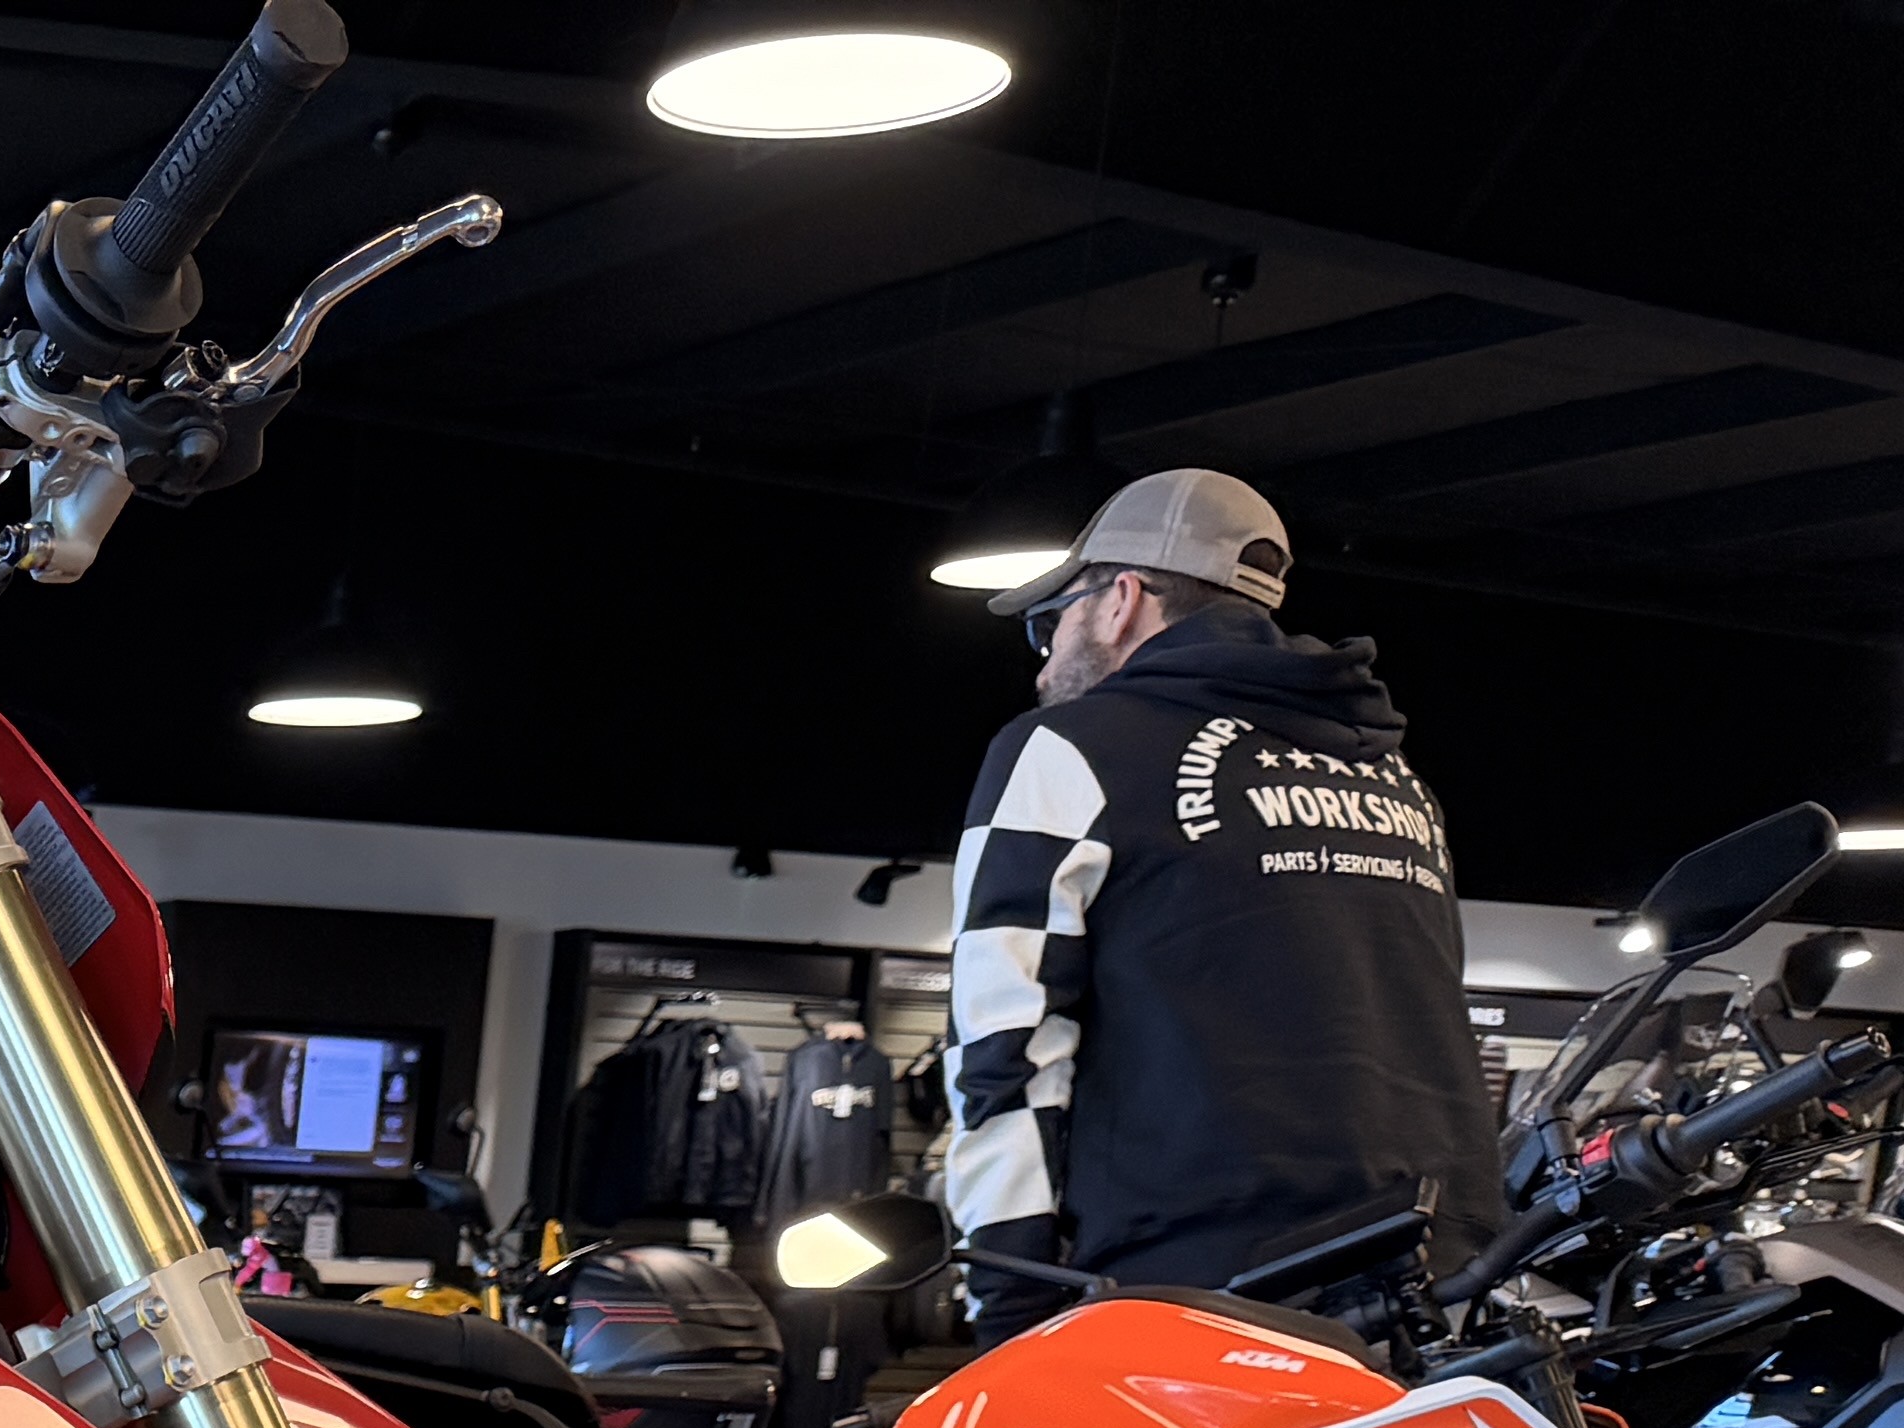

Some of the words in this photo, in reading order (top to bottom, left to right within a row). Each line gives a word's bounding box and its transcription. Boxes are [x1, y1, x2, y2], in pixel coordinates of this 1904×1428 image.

[160, 61, 258, 198] DUCATI
[1245, 785, 1433, 852] WORKSHOP
[1261, 851, 1318, 876] PARTS
[1333, 853, 1405, 881] SERVICING
[1219, 1349, 1307, 1374] KTM
